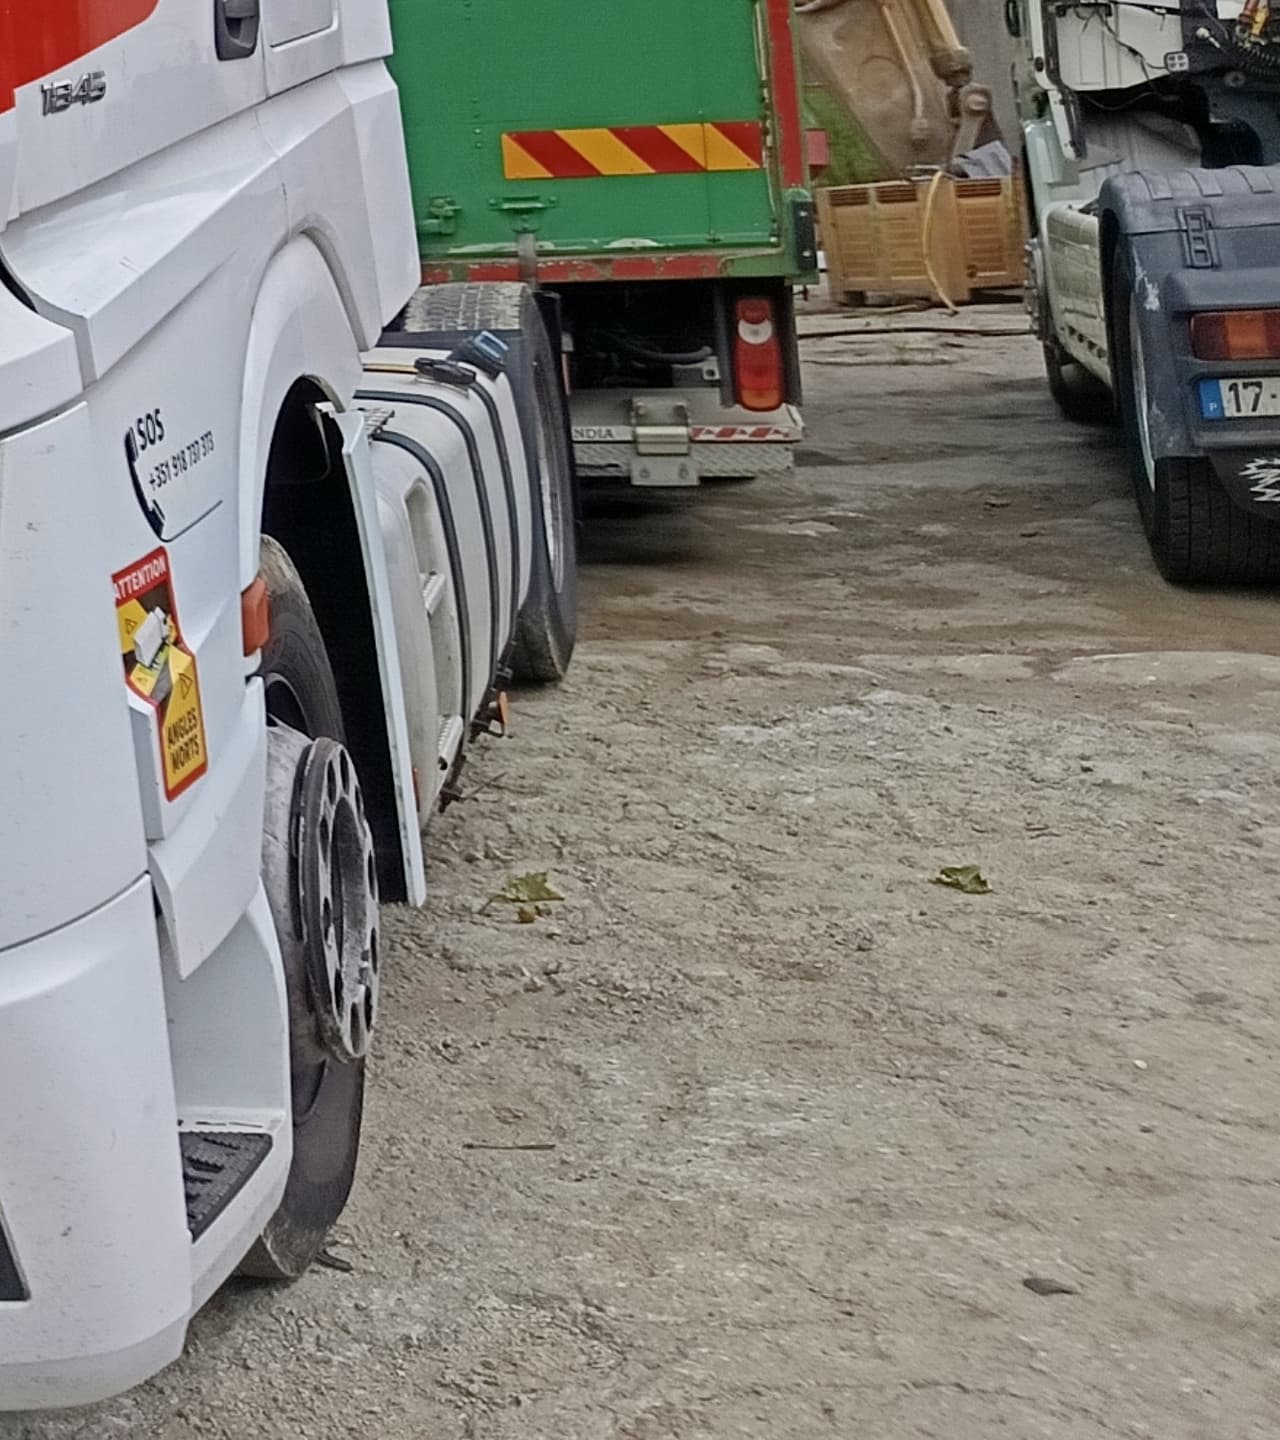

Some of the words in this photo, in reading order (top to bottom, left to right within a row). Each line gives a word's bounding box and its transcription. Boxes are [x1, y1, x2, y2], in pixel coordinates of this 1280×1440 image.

[40, 70, 106, 117] 1845
[136, 408, 164, 451] SOS
[149, 461, 171, 491] +351
[171, 450, 187, 477] 918
[168, 707, 197, 750] ANGLES
[171, 734, 199, 774] MORTS
